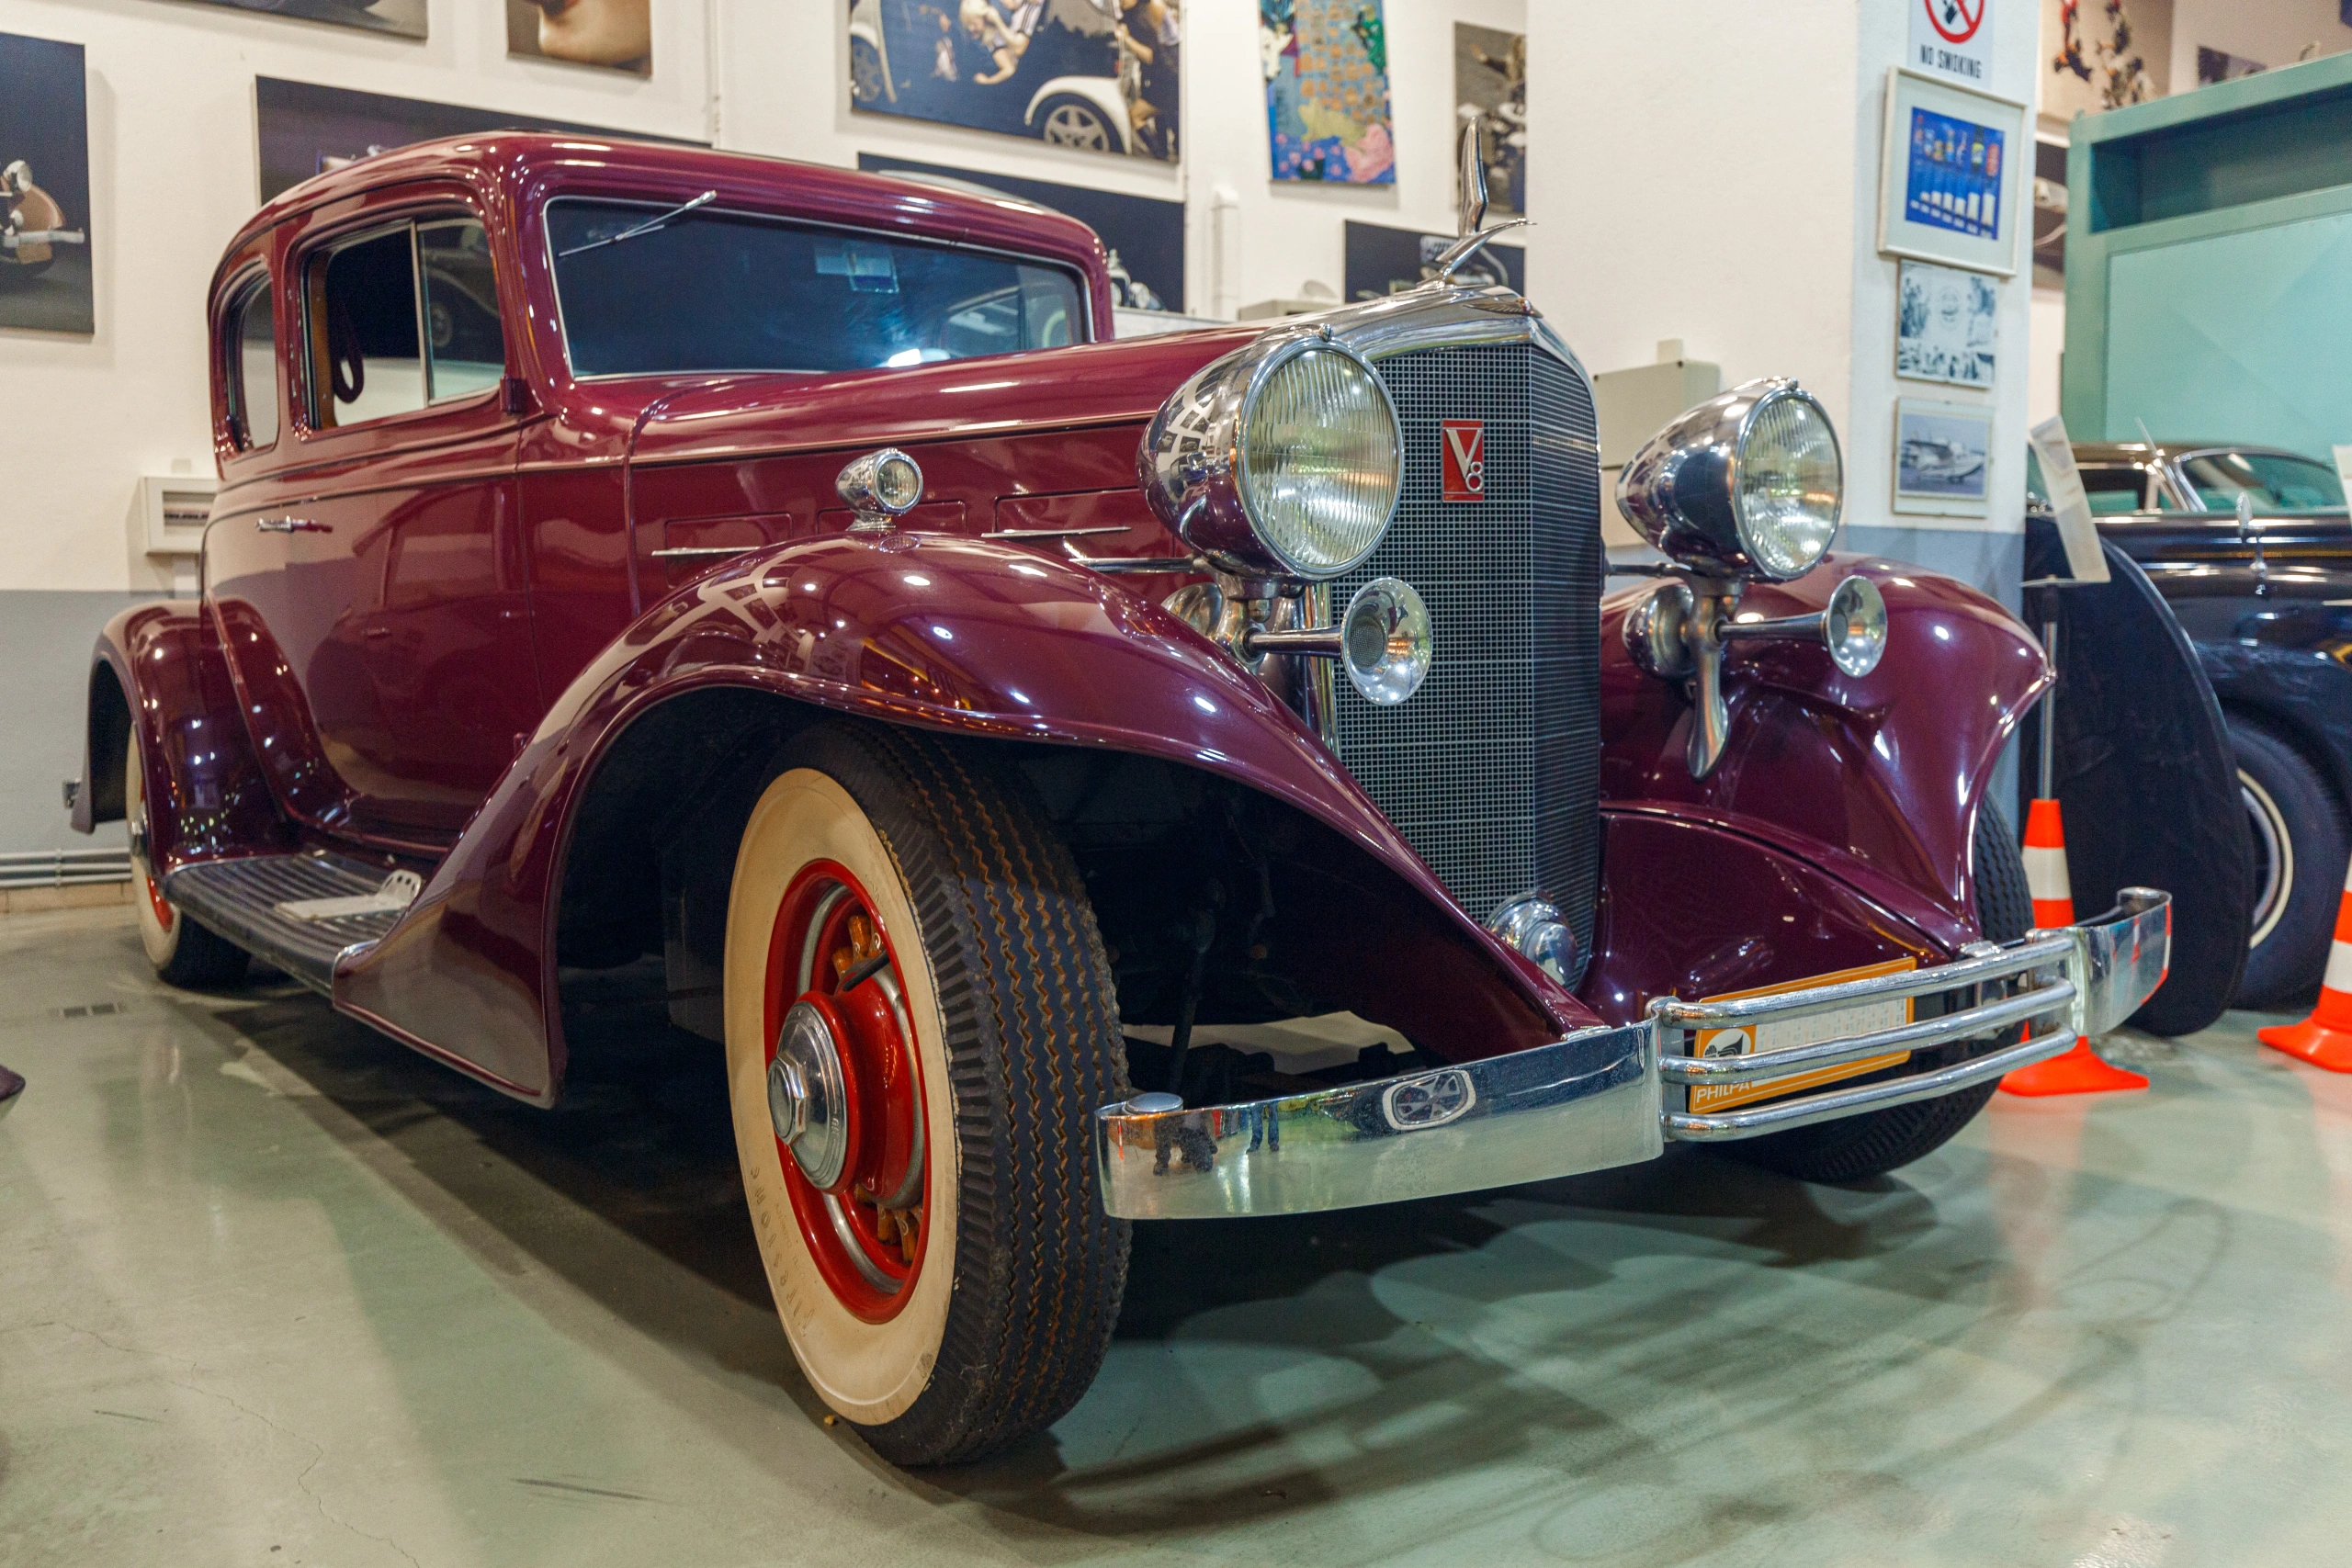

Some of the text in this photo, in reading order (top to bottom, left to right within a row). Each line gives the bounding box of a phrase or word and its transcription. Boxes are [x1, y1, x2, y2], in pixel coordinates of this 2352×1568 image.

[1920, 43, 1982, 79] NO SMOKING
[1445, 429, 1484, 492] V8
